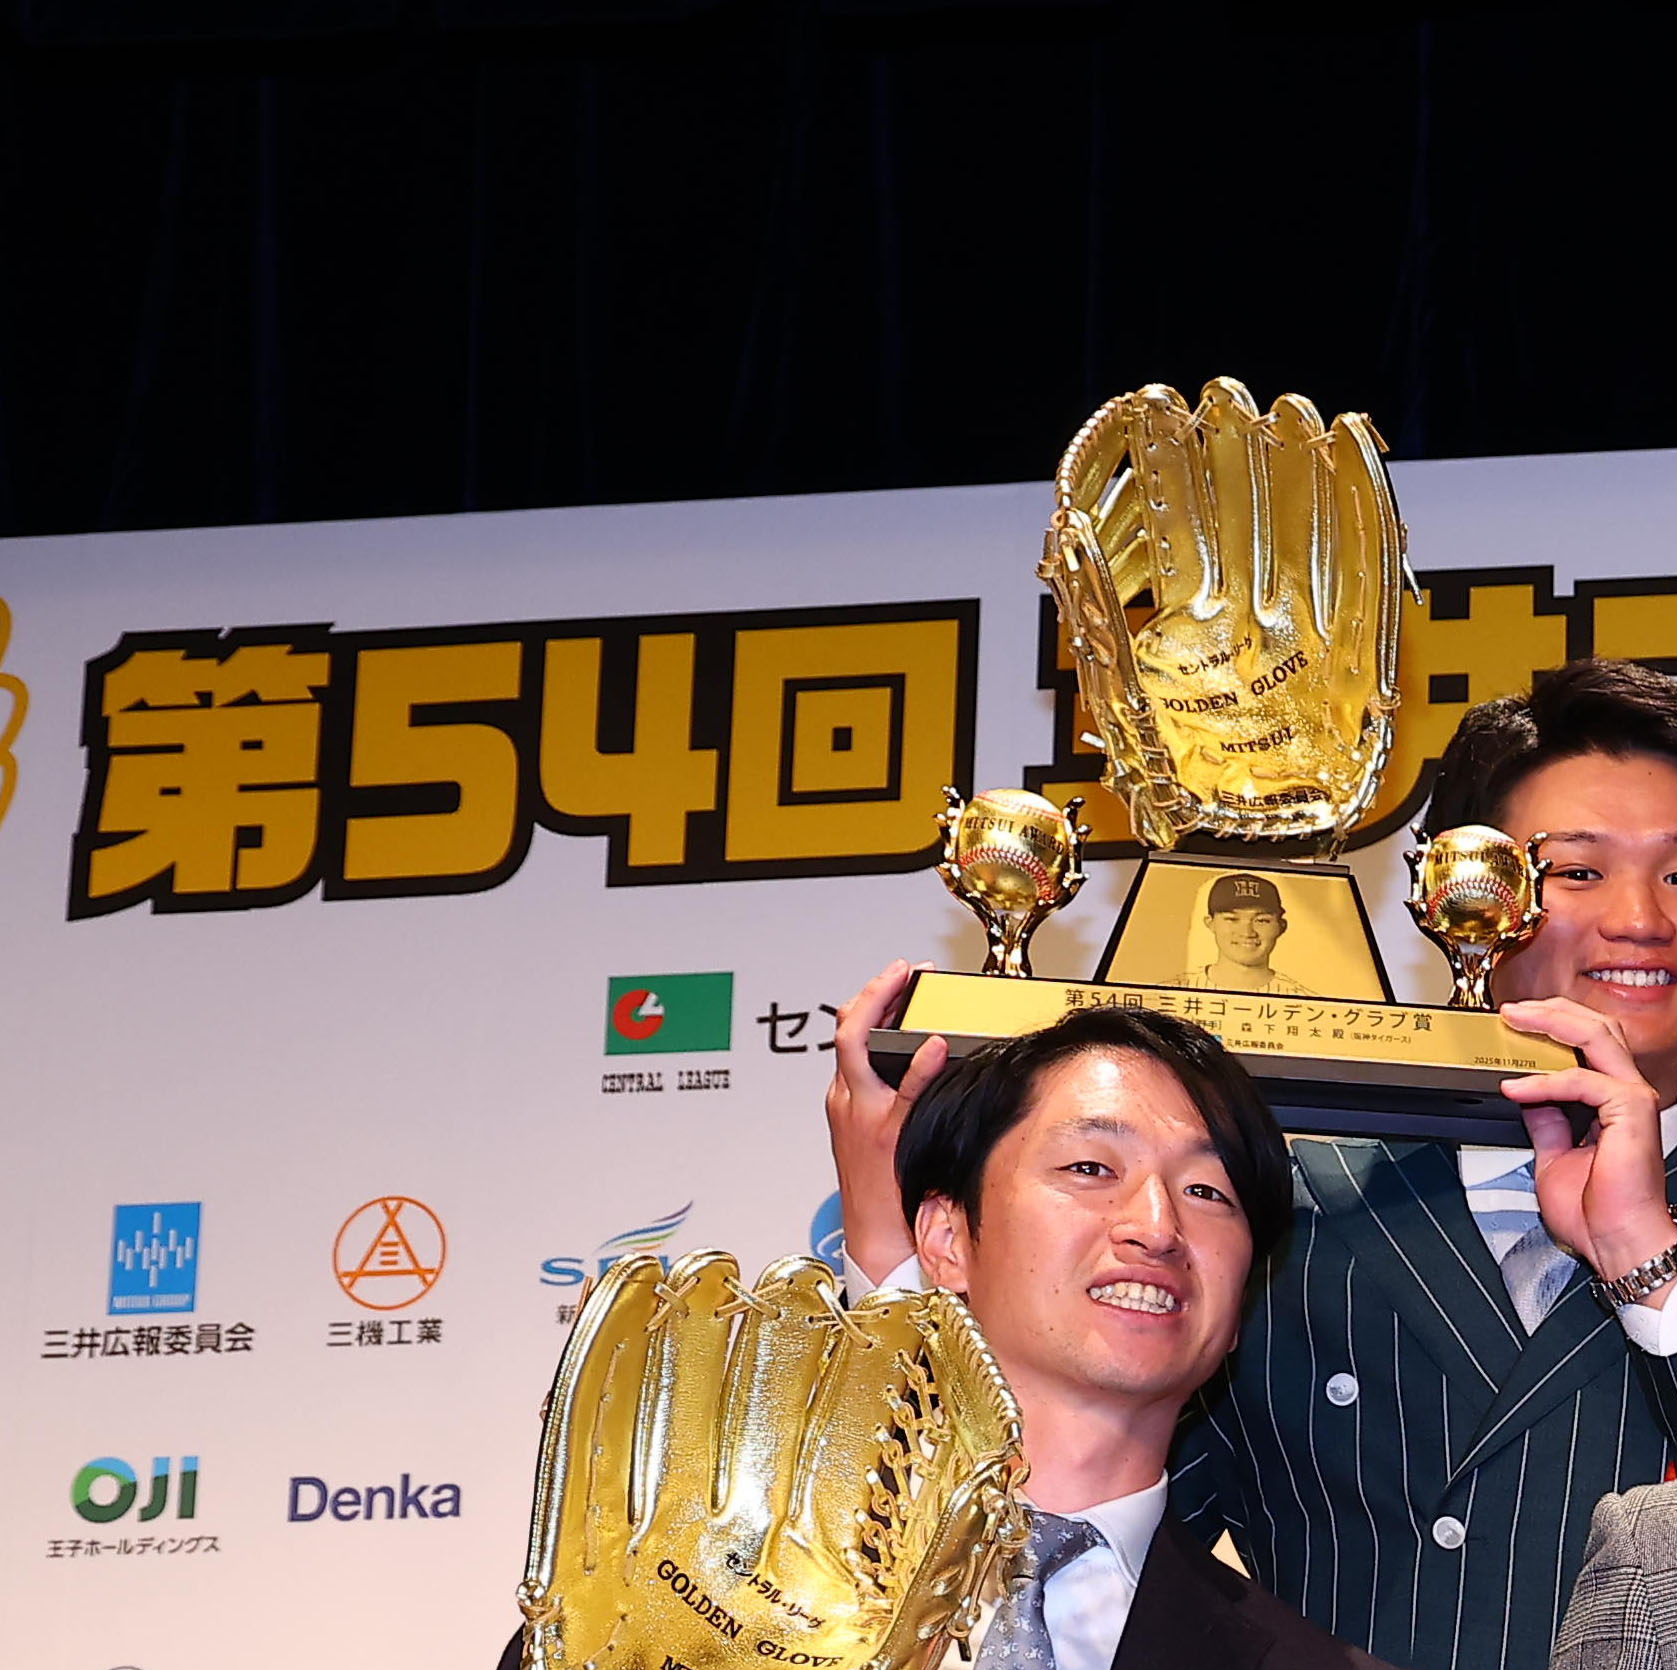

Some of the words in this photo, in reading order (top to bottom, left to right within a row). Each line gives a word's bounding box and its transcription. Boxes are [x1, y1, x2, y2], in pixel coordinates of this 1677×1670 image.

[1251, 651, 1308, 697] GLOVE
[67, 598, 980, 920] 第54回
[1220, 727, 1296, 754] MITSUI
[965, 816, 1015, 833] MITSUI
[1157, 994, 1434, 1033] 三井ゴールデン・グラブ賞
[41, 1322, 255, 1360] 三井広報委員会
[326, 1318, 444, 1348] 三機工業
[71, 1456, 198, 1523] OJI
[287, 1473, 462, 1522] Denka
[46, 1535, 220, 1558] 王子ホールディングス
[657, 1559, 745, 1640] GOLDEN
[723, 1550, 826, 1631] セントラル・リーグ
